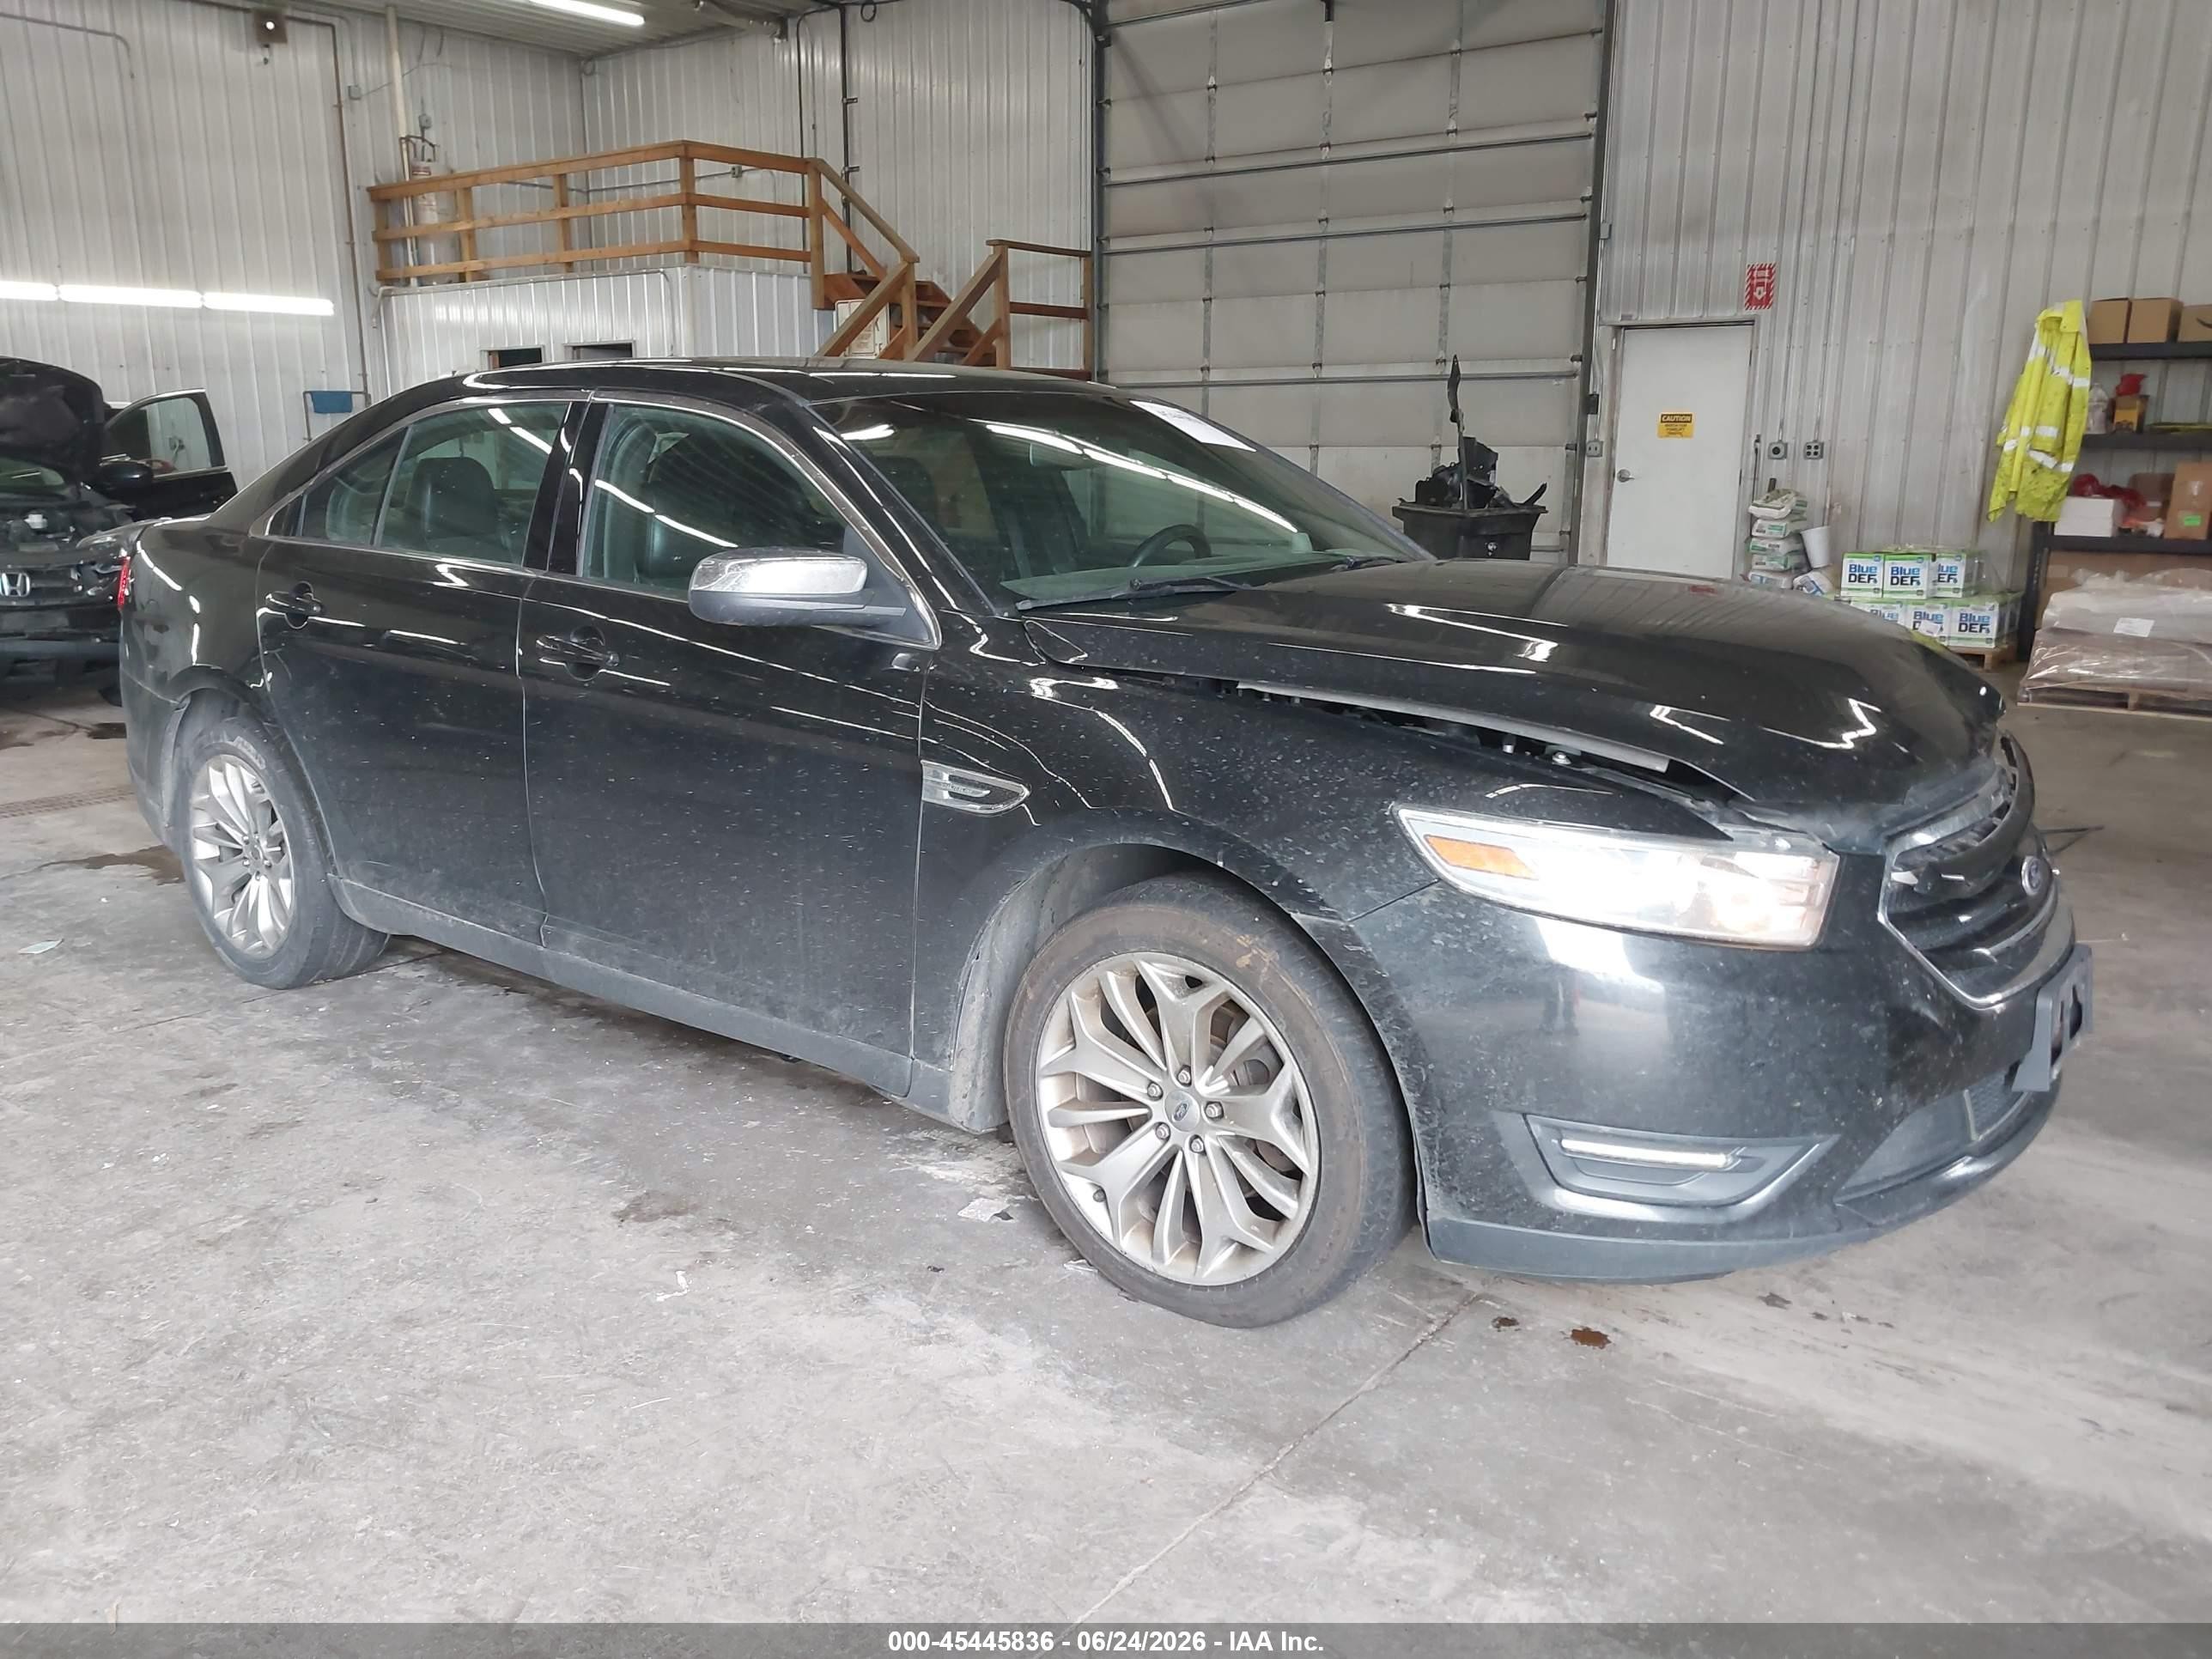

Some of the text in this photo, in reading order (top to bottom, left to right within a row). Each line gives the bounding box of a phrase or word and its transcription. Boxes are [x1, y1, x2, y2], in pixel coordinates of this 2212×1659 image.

[1849, 563, 1877, 573] Blue
[1891, 567, 1920, 575] Blue
[1937, 563, 1958, 573] lue
[1848, 573, 1877, 583] DEF
[1890, 575, 1920, 586] DEF
[1937, 573, 1958, 582] EF
[1914, 611, 1944, 622] Blue
[1960, 613, 1990, 623] Blue
[1958, 623, 1990, 633] DEF
